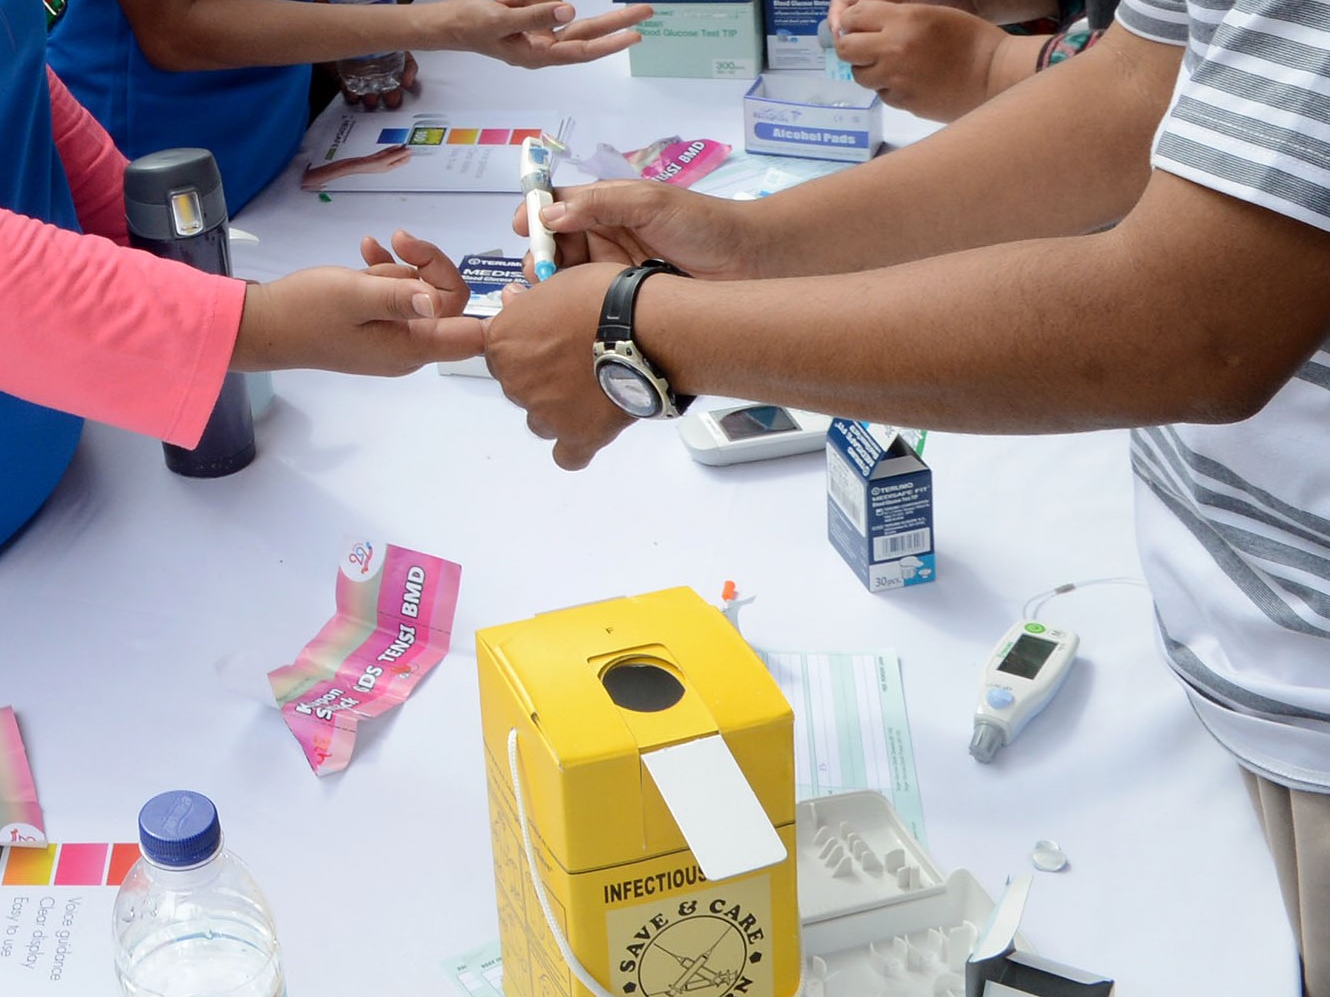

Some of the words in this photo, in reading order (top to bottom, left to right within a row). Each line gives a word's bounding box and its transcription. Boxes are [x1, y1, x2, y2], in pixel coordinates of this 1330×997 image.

[663, 29, 698, 37] Glucose
[701, 29, 720, 37] Test
[772, 128, 822, 142] Alcohol
[823, 133, 856, 144] Pads
[678, 141, 706, 164] BMD
[463, 268, 525, 278] MEDIS
[872, 490, 913, 502] MEDISAFE
[881, 482, 914, 493] TERUMO
[377, 624, 416, 663] TENSI
[401, 565, 426, 618] BMD
[5, 896, 30, 922] Easy
[35, 896, 56, 927] Clear
[61, 896, 83, 927] Voice
[5, 924, 19, 935] to
[619, 913, 669, 973] SAVE
[677, 900, 698, 916] &
[709, 899, 764, 945] CARE
[0, 939, 13, 957] use
[21, 929, 49, 969] display
[50, 930, 74, 981] guidance
